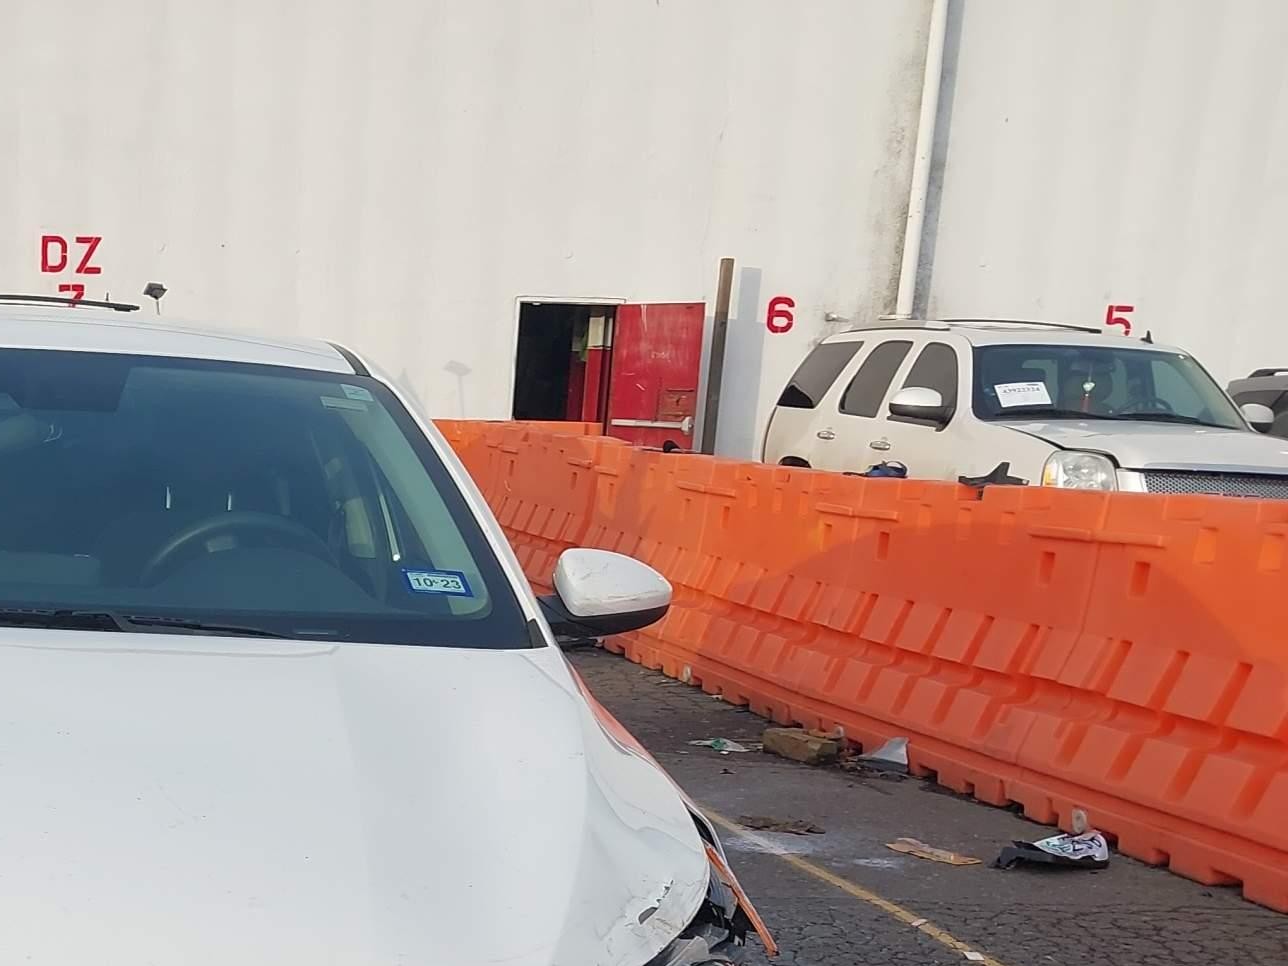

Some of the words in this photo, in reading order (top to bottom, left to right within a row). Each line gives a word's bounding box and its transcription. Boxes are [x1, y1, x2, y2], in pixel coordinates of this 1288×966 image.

[41, 235, 102, 274] DZ
[767, 296, 795, 333] 6
[1106, 305, 1134, 336] 5
